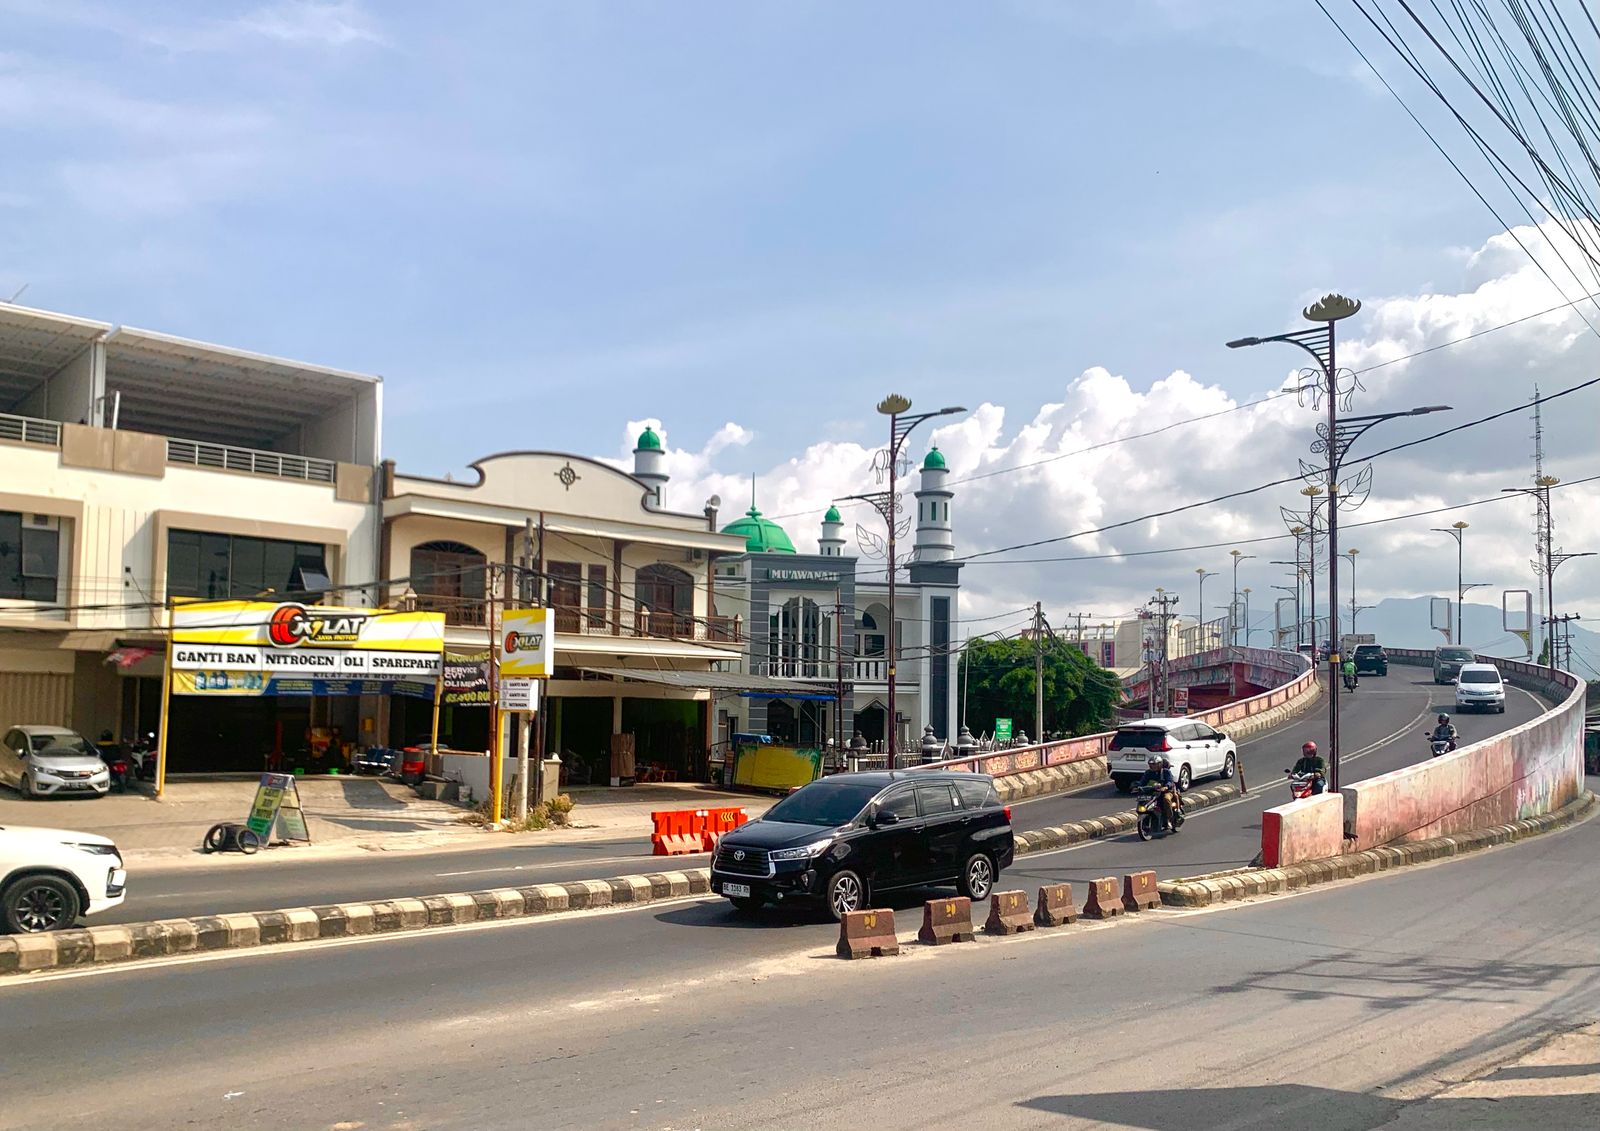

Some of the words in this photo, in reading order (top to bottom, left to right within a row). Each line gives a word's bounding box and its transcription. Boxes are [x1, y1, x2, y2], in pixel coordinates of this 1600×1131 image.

[177, 652, 222, 662] GANTI
[227, 654, 256, 664] BAN
[265, 654, 334, 666] NITROGEN
[344, 656, 364, 667] OLI
[372, 657, 440, 669] SPAREPART
